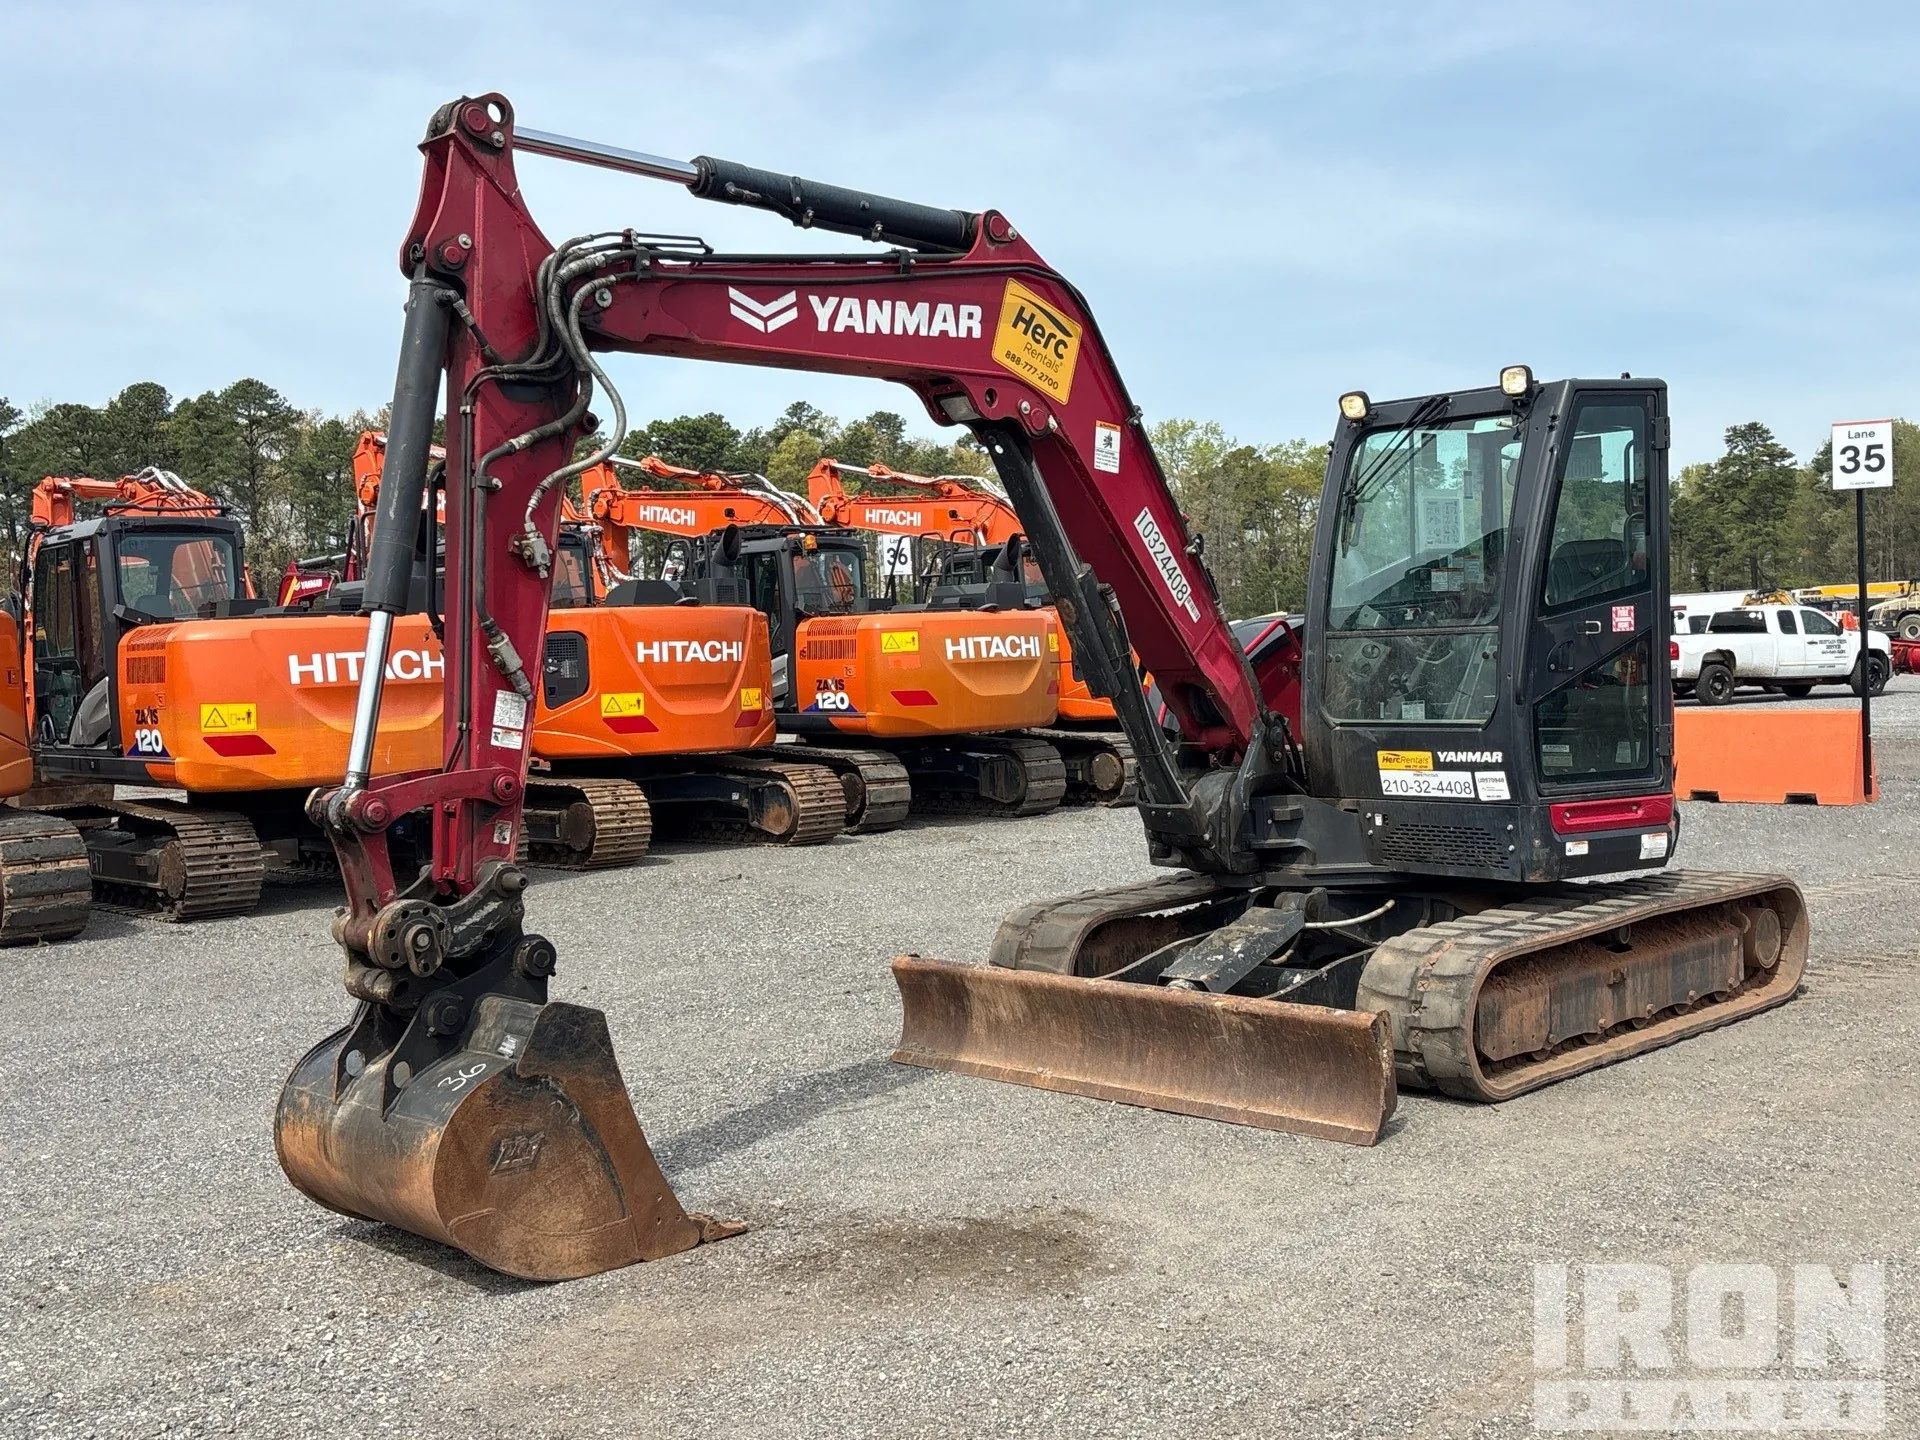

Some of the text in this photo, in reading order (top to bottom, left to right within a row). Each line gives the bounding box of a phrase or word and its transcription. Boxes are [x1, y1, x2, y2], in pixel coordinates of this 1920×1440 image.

[808, 295, 982, 338] YANMAR
[1011, 305, 1068, 360] Herc
[1004, 350, 1059, 390] 888-777-2700
[1848, 430, 1876, 439] Lane
[1839, 444, 1885, 474] 35
[640, 505, 696, 526] HITACHI
[865, 509, 921, 527] HITACHI
[887, 547, 908, 566] 36
[1137, 509, 1189, 602] 10324408
[637, 641, 742, 662] HITACHI
[945, 635, 1040, 660] HITACHI
[816, 677, 844, 691] ZAXIS
[816, 692, 849, 710] 120
[135, 706, 159, 725] ZAXIS
[135, 728, 162, 753] 120
[1437, 751, 1503, 763] YANMAR
[1383, 779, 1472, 795] 210-32-4408
[437, 1063, 487, 1092] 36
